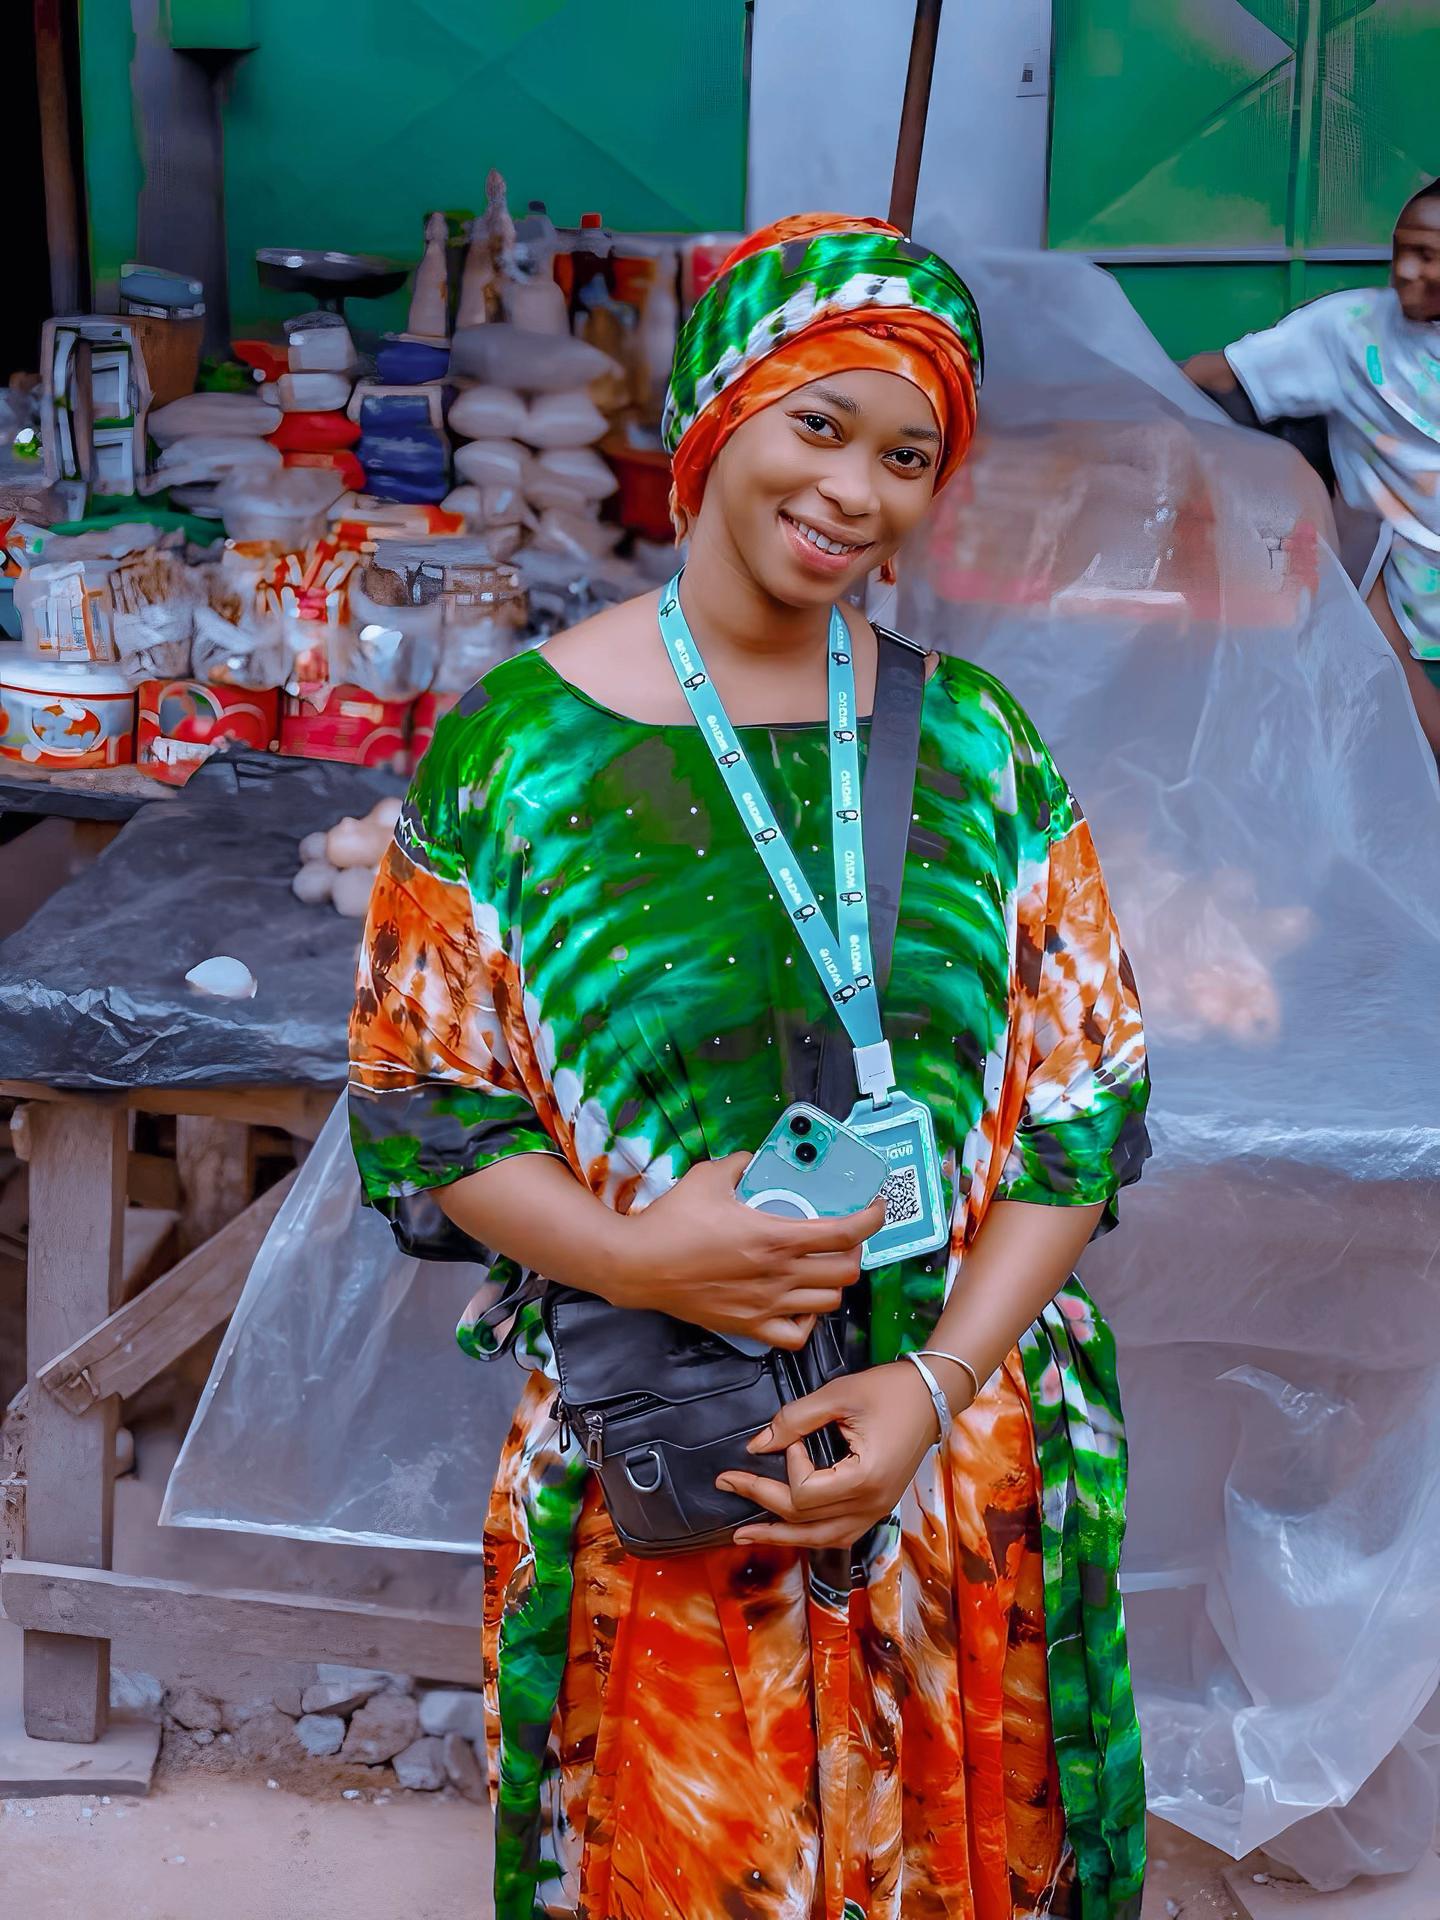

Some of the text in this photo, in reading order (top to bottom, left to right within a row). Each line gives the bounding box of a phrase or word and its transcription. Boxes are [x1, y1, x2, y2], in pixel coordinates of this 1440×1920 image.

[779, 867, 803, 905] wave
[819, 948, 843, 987] wave
[849, 934, 862, 975] wave
[886, 1143, 914, 1160] ave
